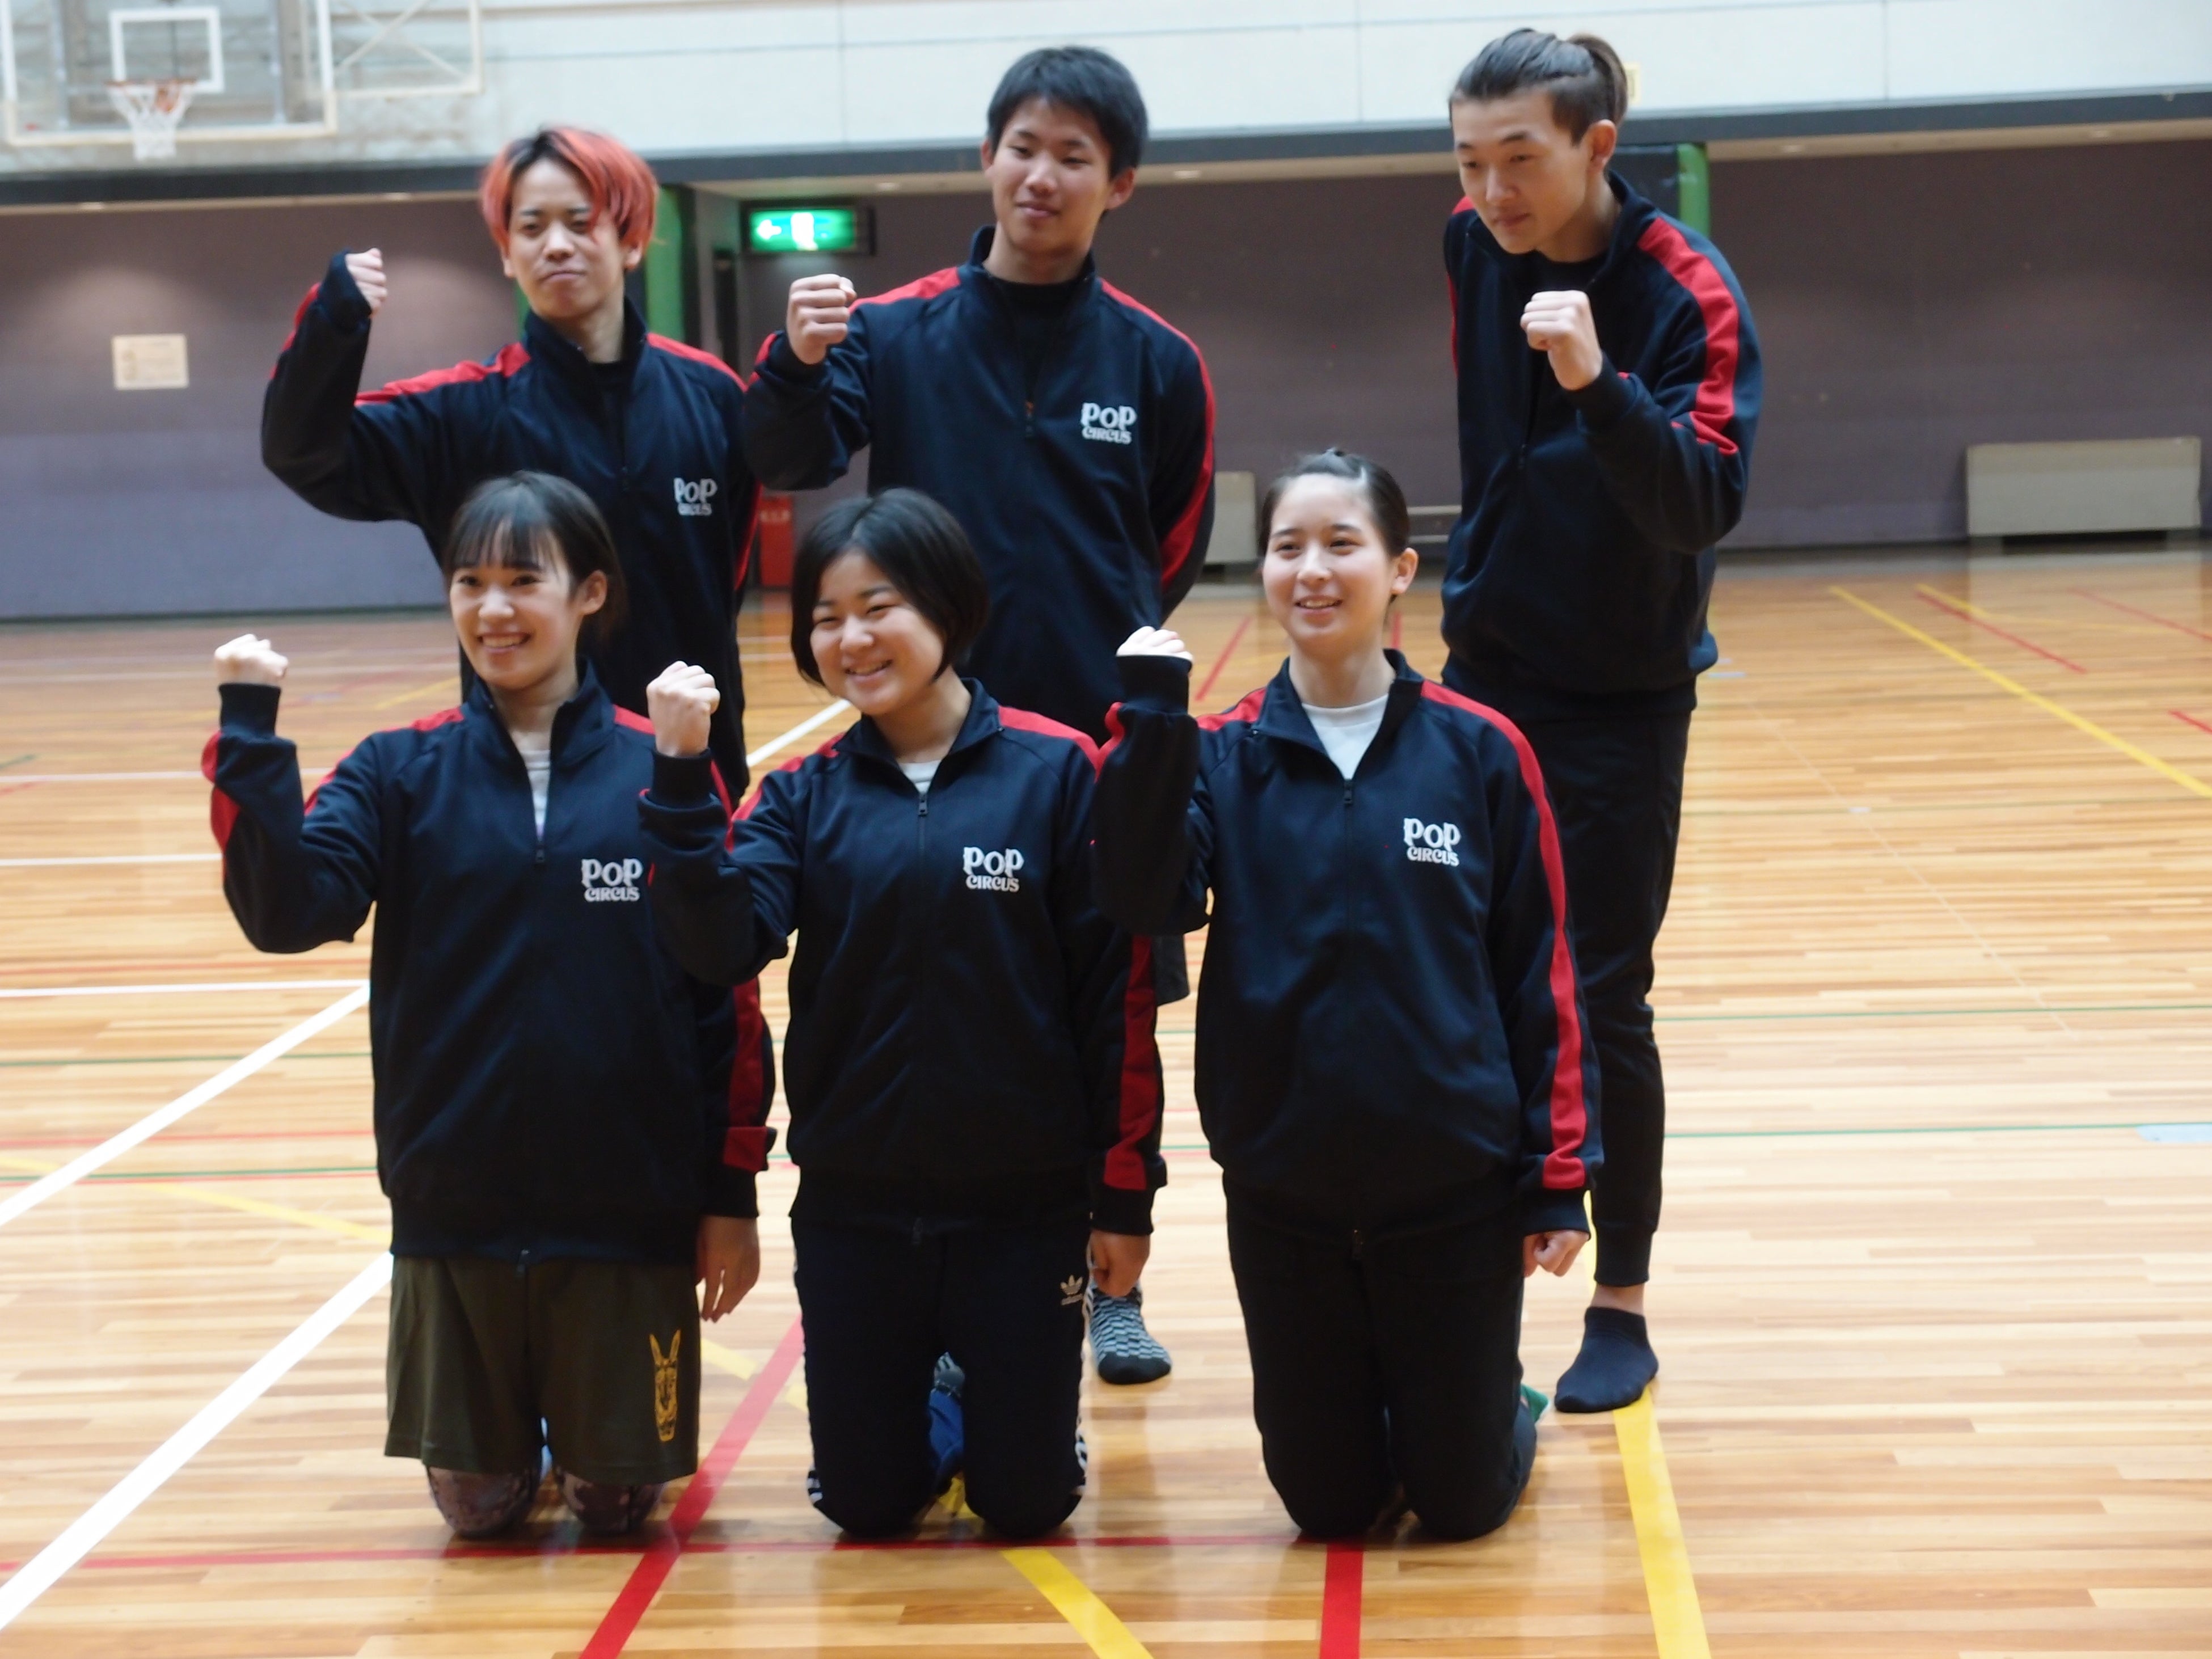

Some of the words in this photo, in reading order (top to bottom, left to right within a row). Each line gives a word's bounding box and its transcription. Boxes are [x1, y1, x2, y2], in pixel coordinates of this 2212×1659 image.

[1080, 402, 1137, 431] POP
[1403, 817, 1462, 852] POP
[963, 846, 1024, 878] POP
[1407, 846, 1459, 867] CIRCUS
[581, 858, 644, 888] POP
[966, 875, 1020, 893] CIRCUS
[584, 886, 640, 902] CIRCUS
